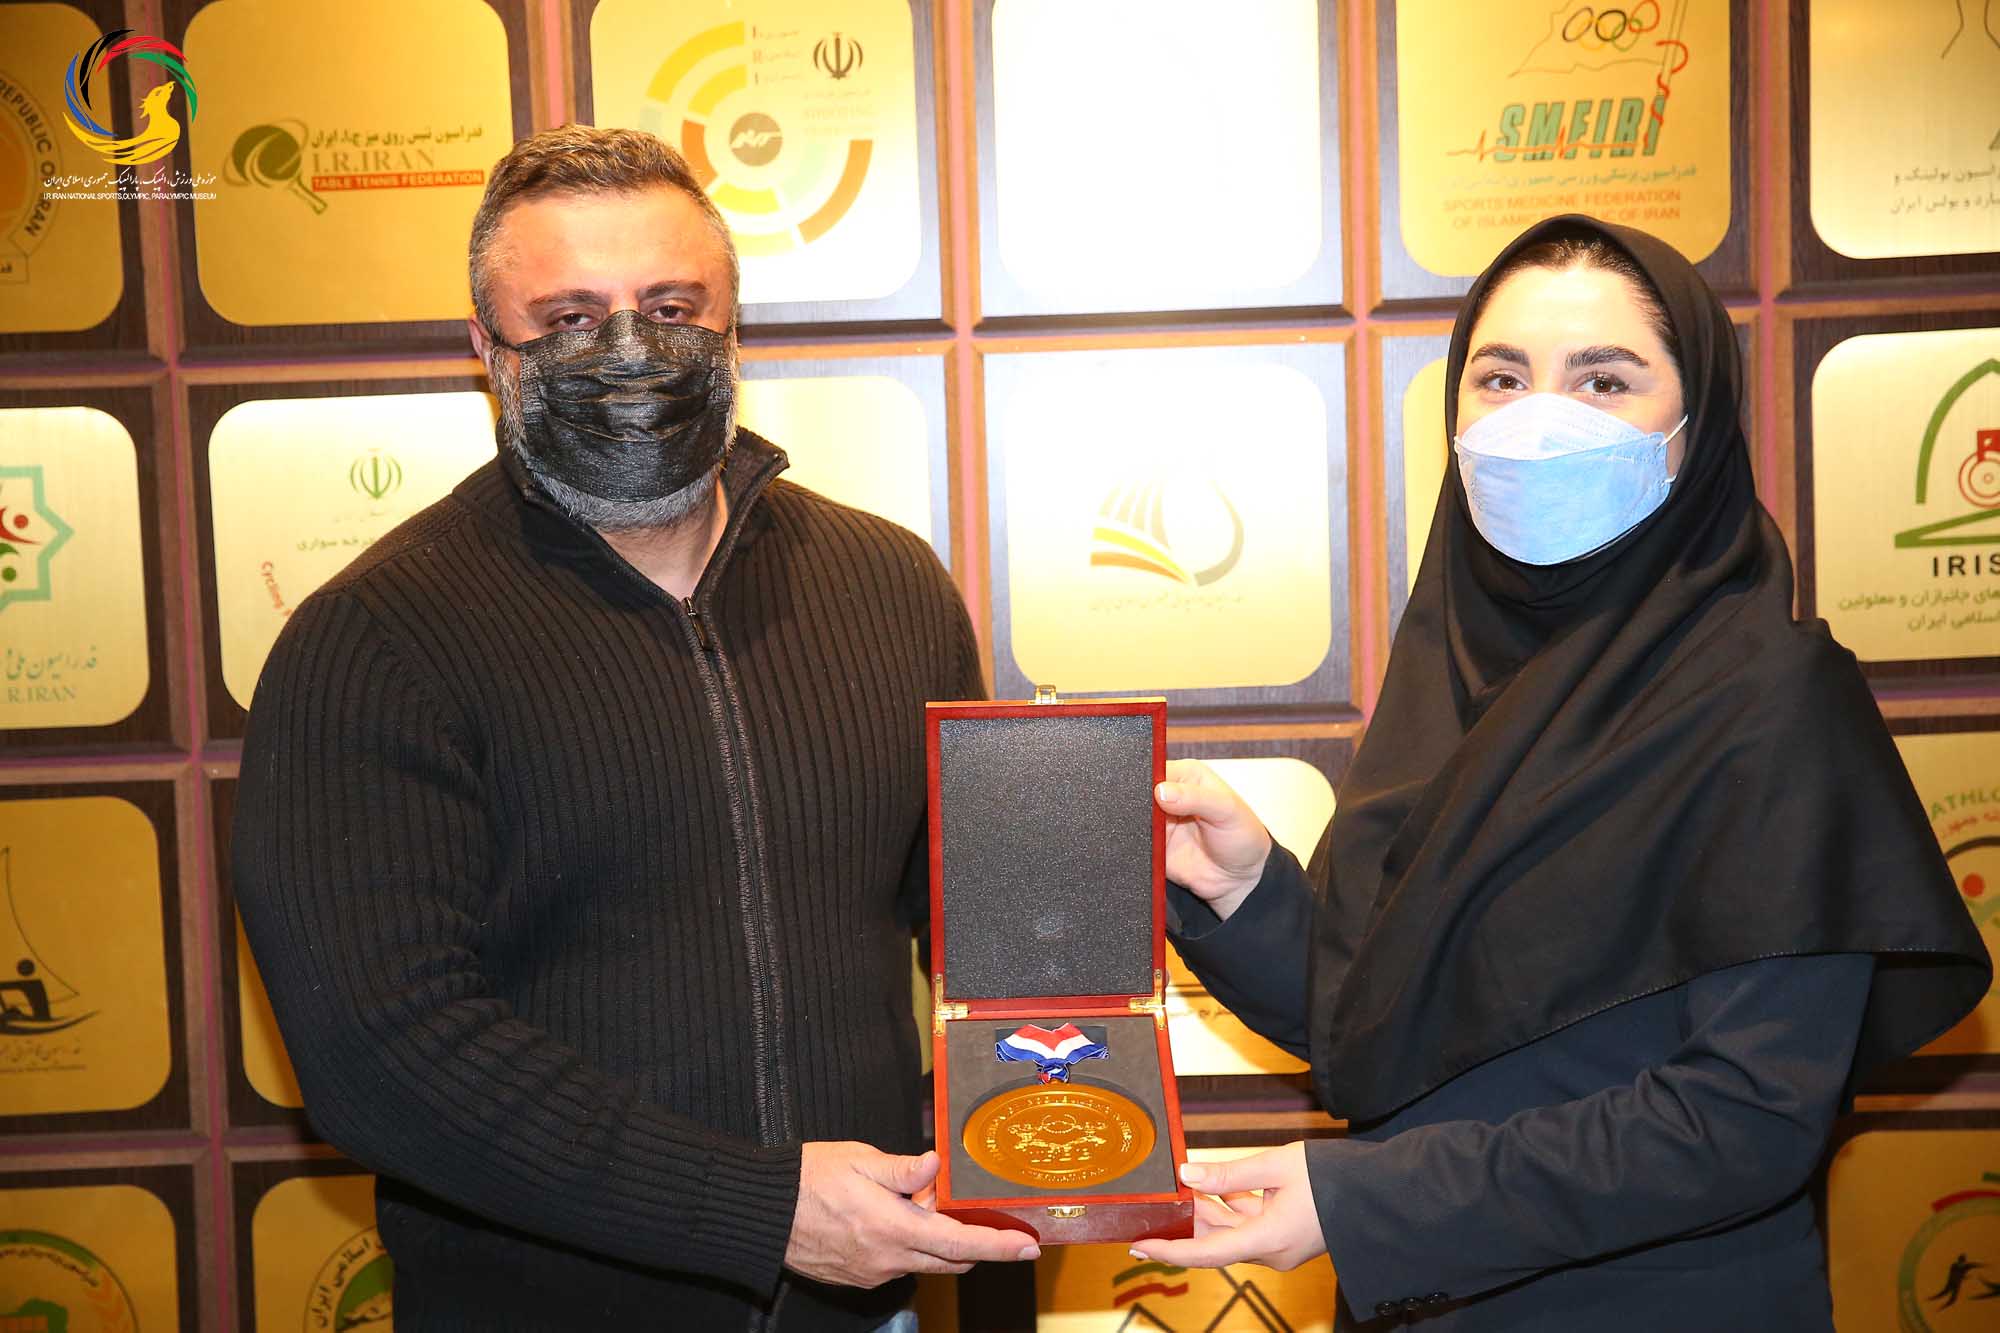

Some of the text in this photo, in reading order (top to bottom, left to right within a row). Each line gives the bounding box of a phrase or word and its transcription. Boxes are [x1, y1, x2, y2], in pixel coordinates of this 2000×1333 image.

[312, 149, 435, 173] I.R.IRAN
[314, 172, 482, 190] TABLE TENNIS FEDERATION
[1584, 188, 1681, 206] FEDERATION
[24, 194, 51, 237] RAN
